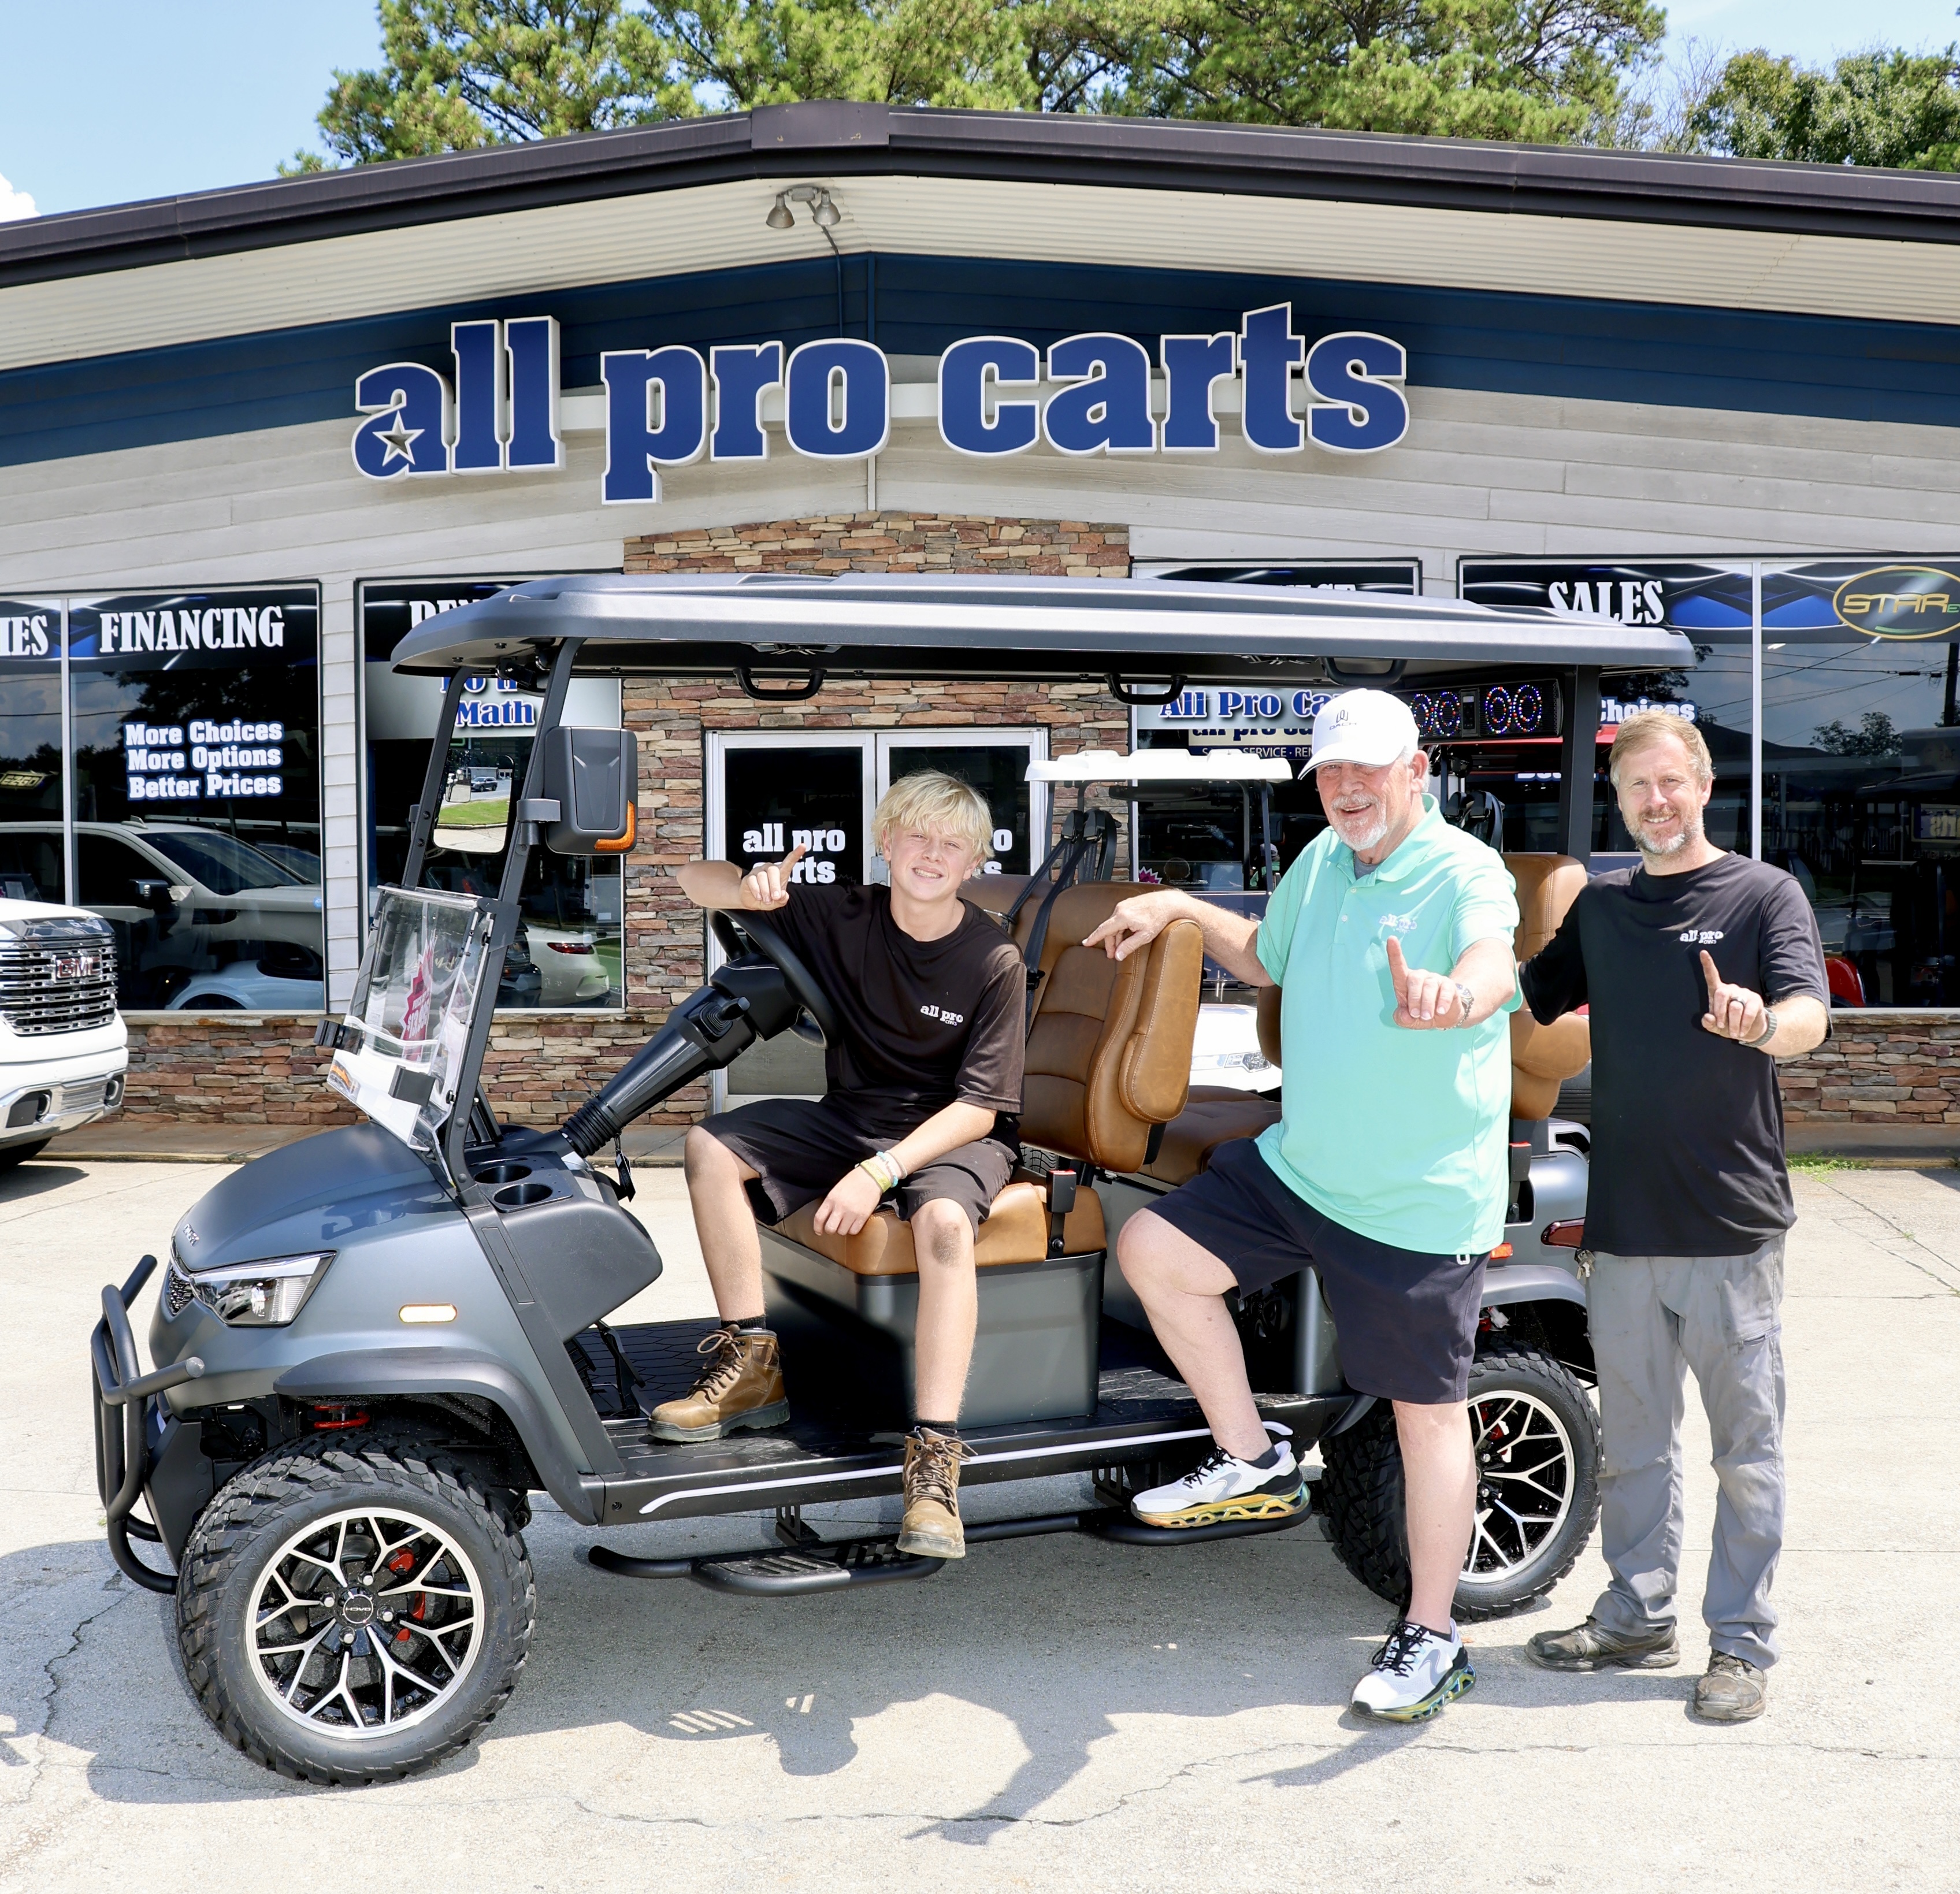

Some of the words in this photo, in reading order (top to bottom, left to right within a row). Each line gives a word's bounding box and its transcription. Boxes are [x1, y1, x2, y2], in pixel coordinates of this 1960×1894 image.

[351, 315, 566, 480] all
[600, 338, 890, 504] pro
[938, 301, 1410, 456] carts
[1549, 581, 1664, 623] SALES
[99, 606, 285, 653] FINANCING
[455, 699, 536, 727] Math
[1217, 690, 1282, 718] Pro
[125, 724, 183, 745] More
[190, 719, 283, 743] Choices
[128, 749, 185, 771] More
[192, 745, 282, 773] Options
[1243, 747, 1287, 757] SERVICE
[129, 776, 200, 798] Better
[206, 773, 282, 796] Prices
[743, 823, 784, 852] all
[792, 829, 845, 859] pro
[1680, 930, 1698, 942] all
[1698, 931, 1724, 944] pro
[57, 956, 101, 978] GMC
[920, 1005, 940, 1017] all
[940, 1010, 963, 1023] pro
